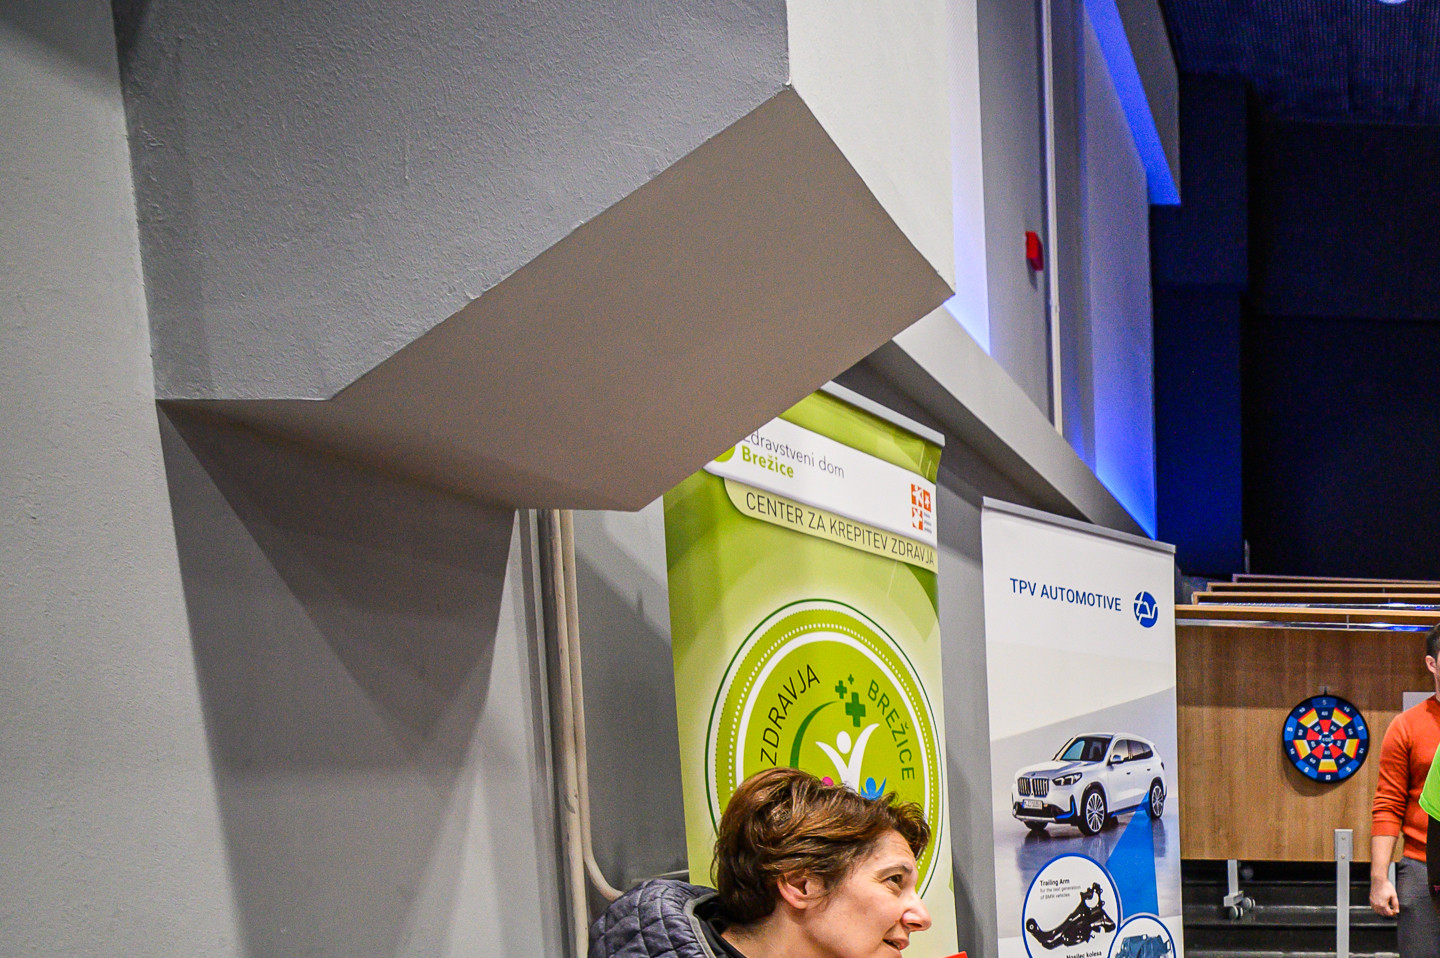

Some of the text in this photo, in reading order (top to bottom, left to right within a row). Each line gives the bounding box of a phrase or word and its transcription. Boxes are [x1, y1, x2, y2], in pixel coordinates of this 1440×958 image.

[741, 445, 794, 478] Brežice
[818, 454, 845, 479] dom
[746, 491, 935, 565] CENTER ZA KREPITEV ZDRAVJA
[1009, 577, 1122, 612] TPV AUTOMOTIVE
[760, 664, 821, 766] ZDRAVJA
[867, 679, 915, 781] BREŽICE
